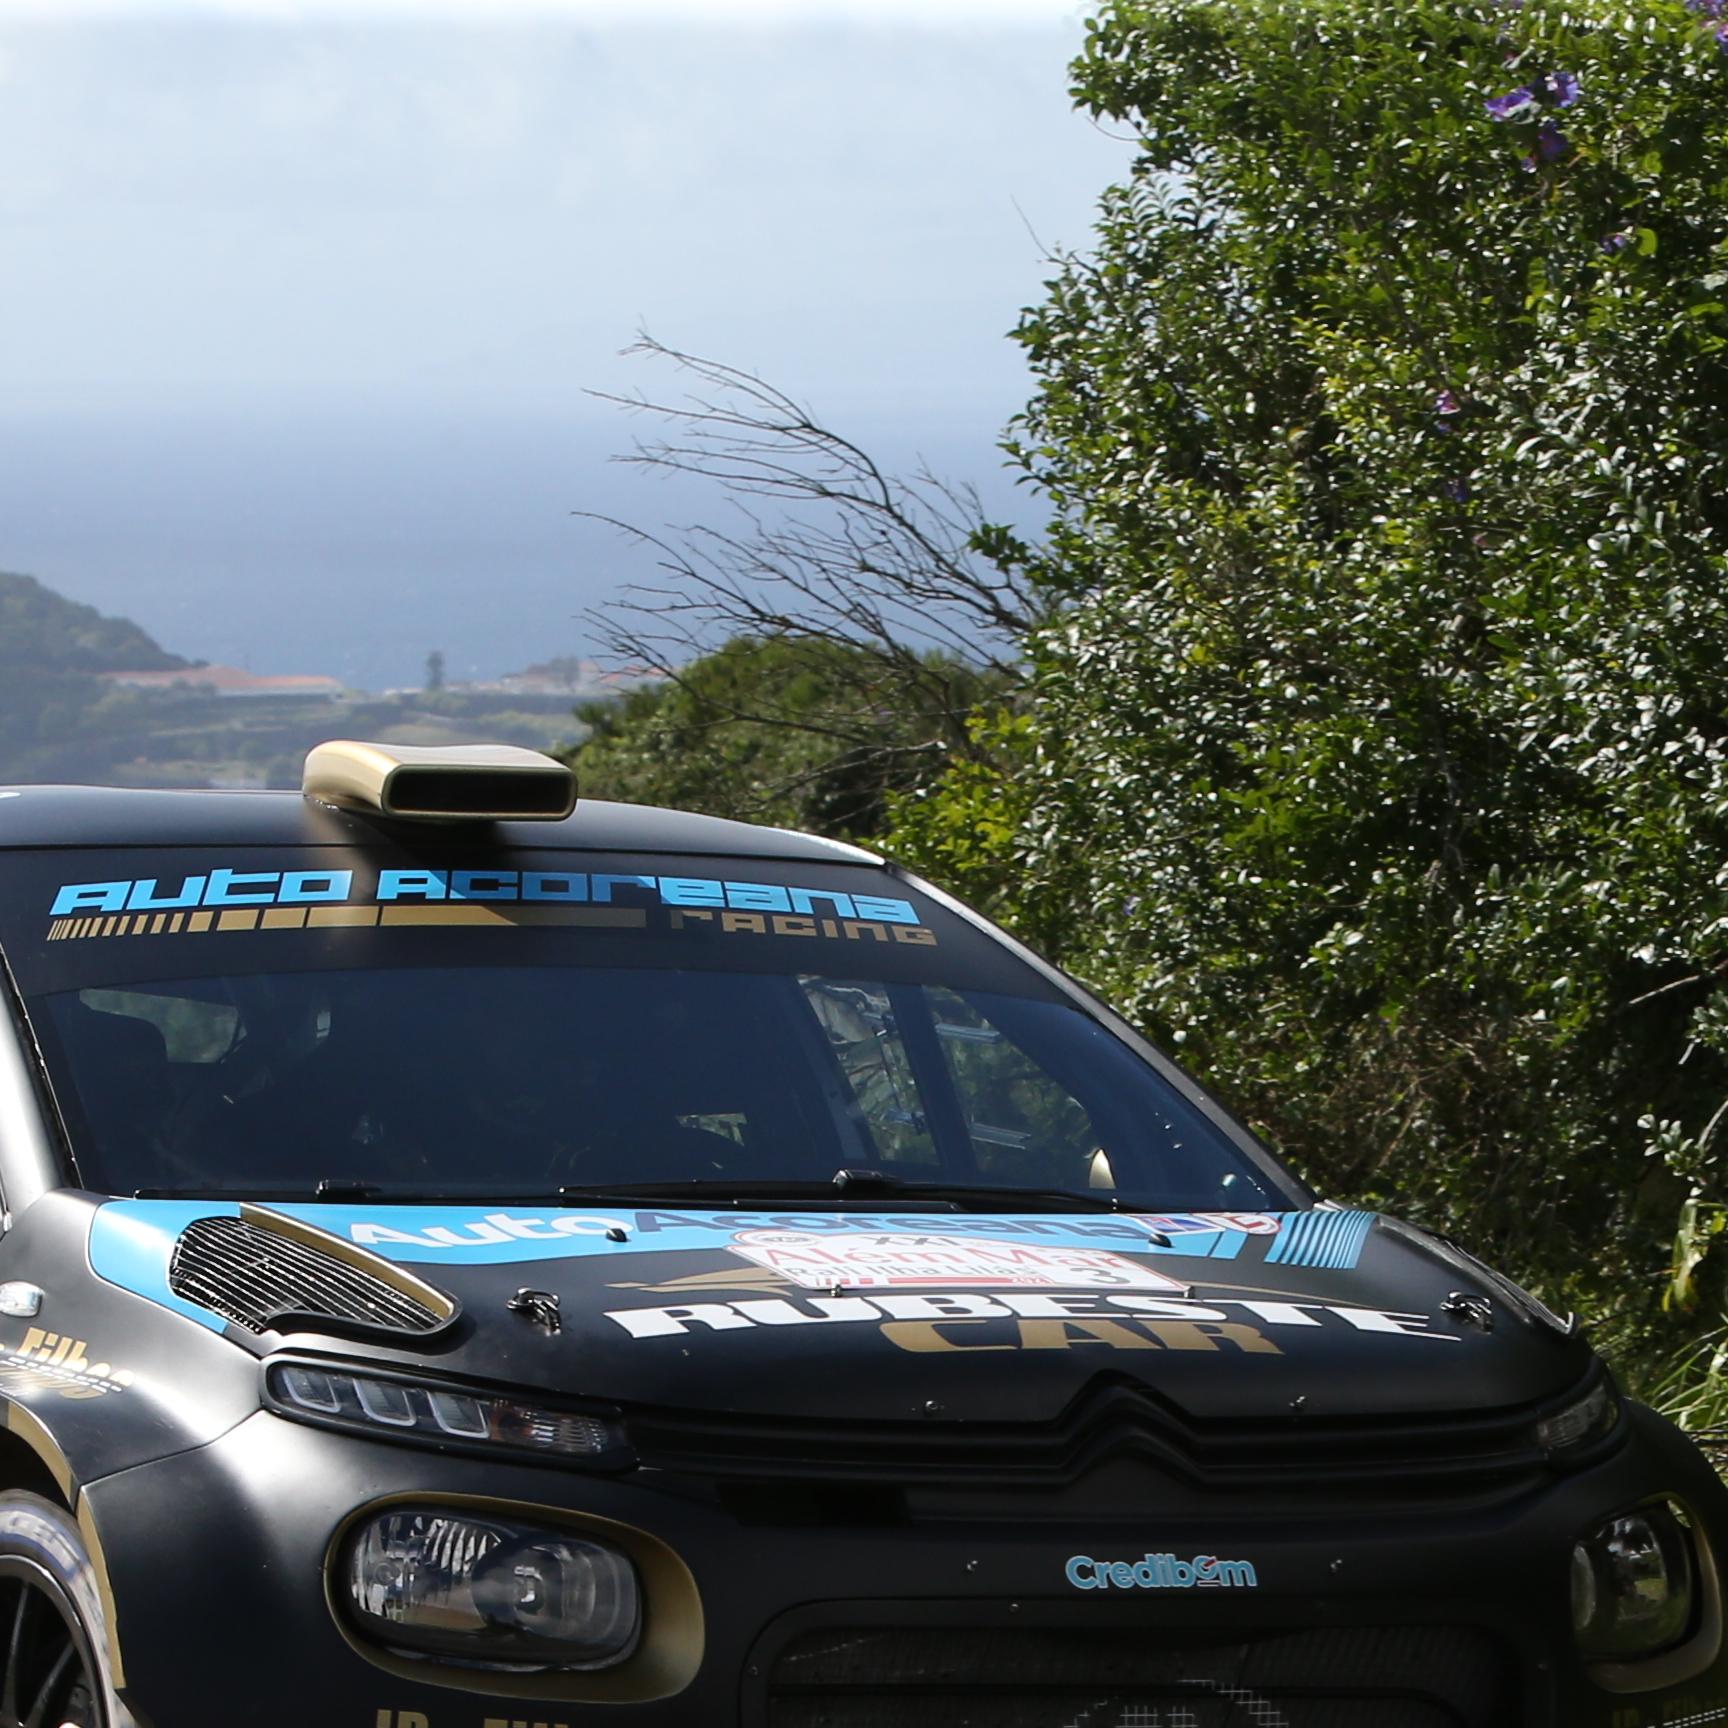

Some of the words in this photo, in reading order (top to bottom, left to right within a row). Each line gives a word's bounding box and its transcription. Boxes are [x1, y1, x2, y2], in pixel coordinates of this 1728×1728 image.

[350, 1212, 635, 1248] Auto
[765, 1246, 966, 1266] Além
[961, 1247, 1126, 1269] Mar
[1069, 1266, 1132, 1285] 3
[602, 1293, 1462, 1342] RUBESTE
[879, 1319, 1285, 1354] CAR
[1064, 1552, 1259, 1591] Credibom
